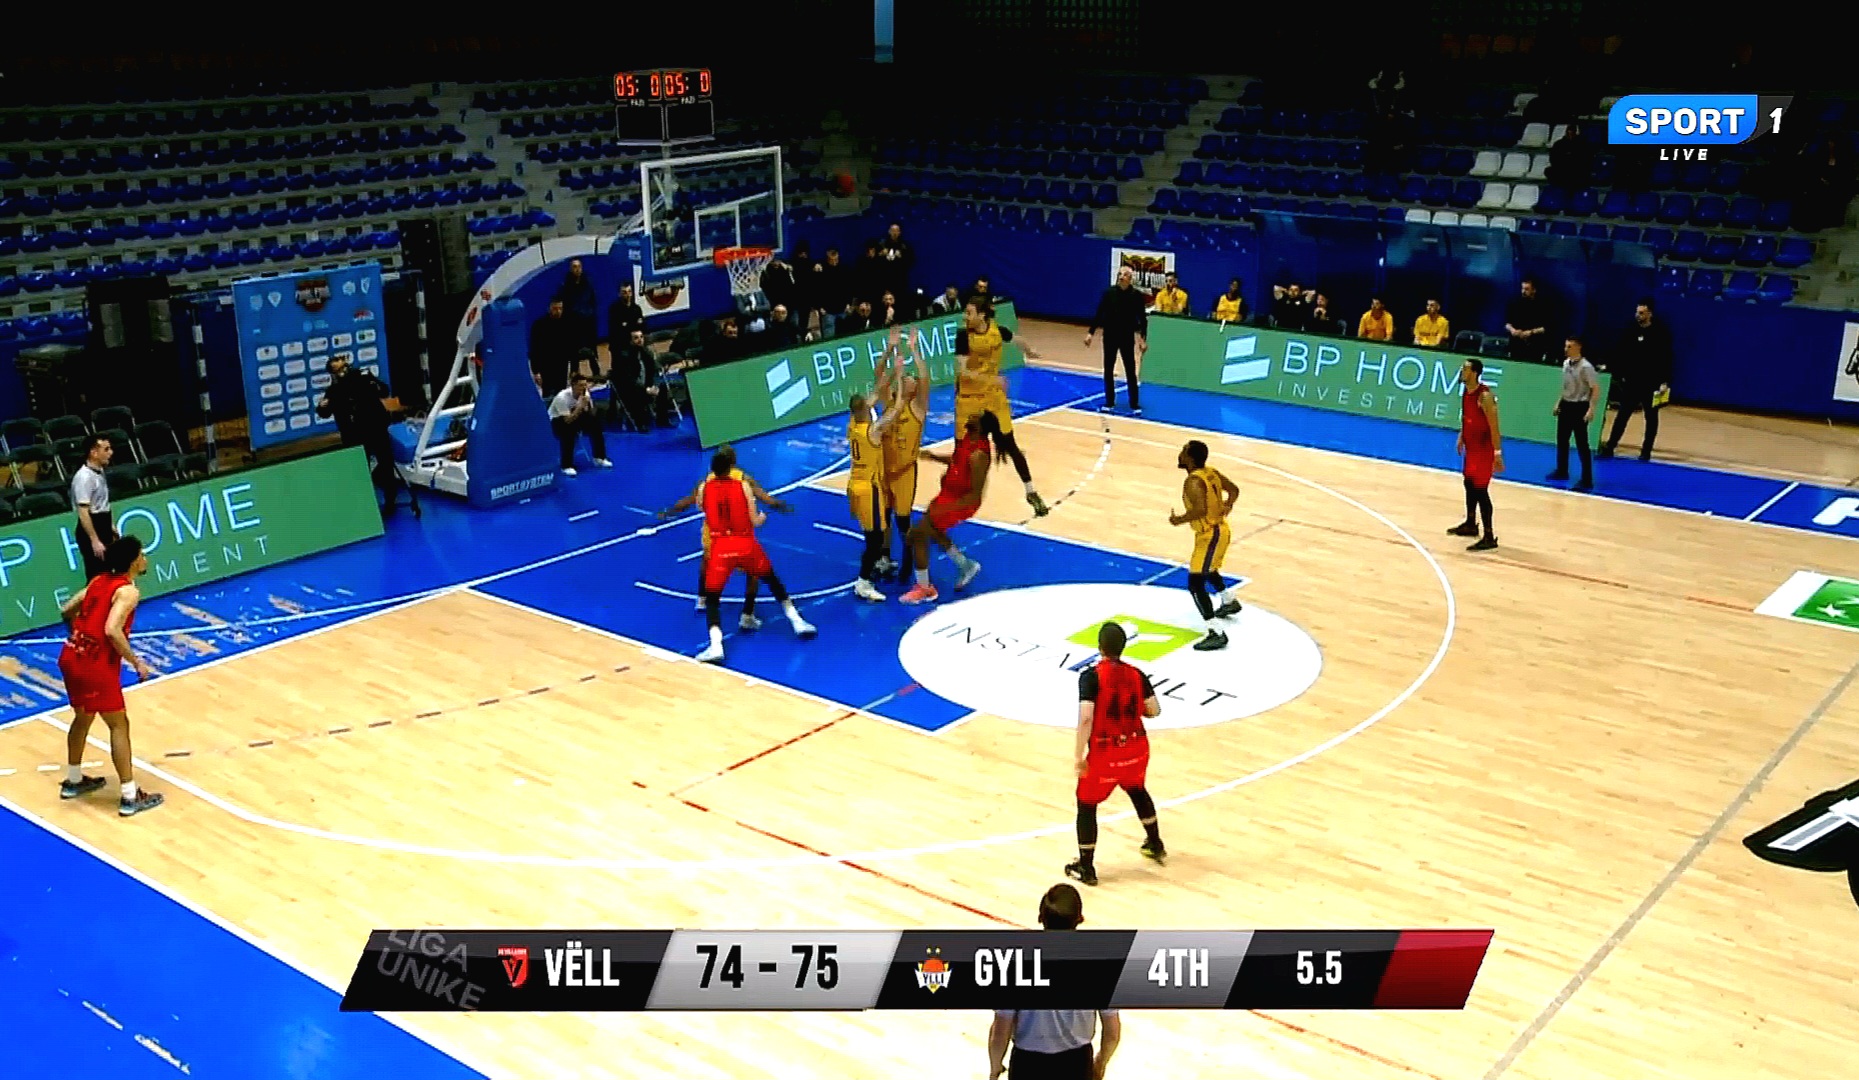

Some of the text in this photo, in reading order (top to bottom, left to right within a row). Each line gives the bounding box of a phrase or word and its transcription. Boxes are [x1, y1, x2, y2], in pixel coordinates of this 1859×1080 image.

[812, 345, 856, 386] BP
[1282, 340, 1341, 377] BP
[1277, 380, 1465, 423] INVESTME
